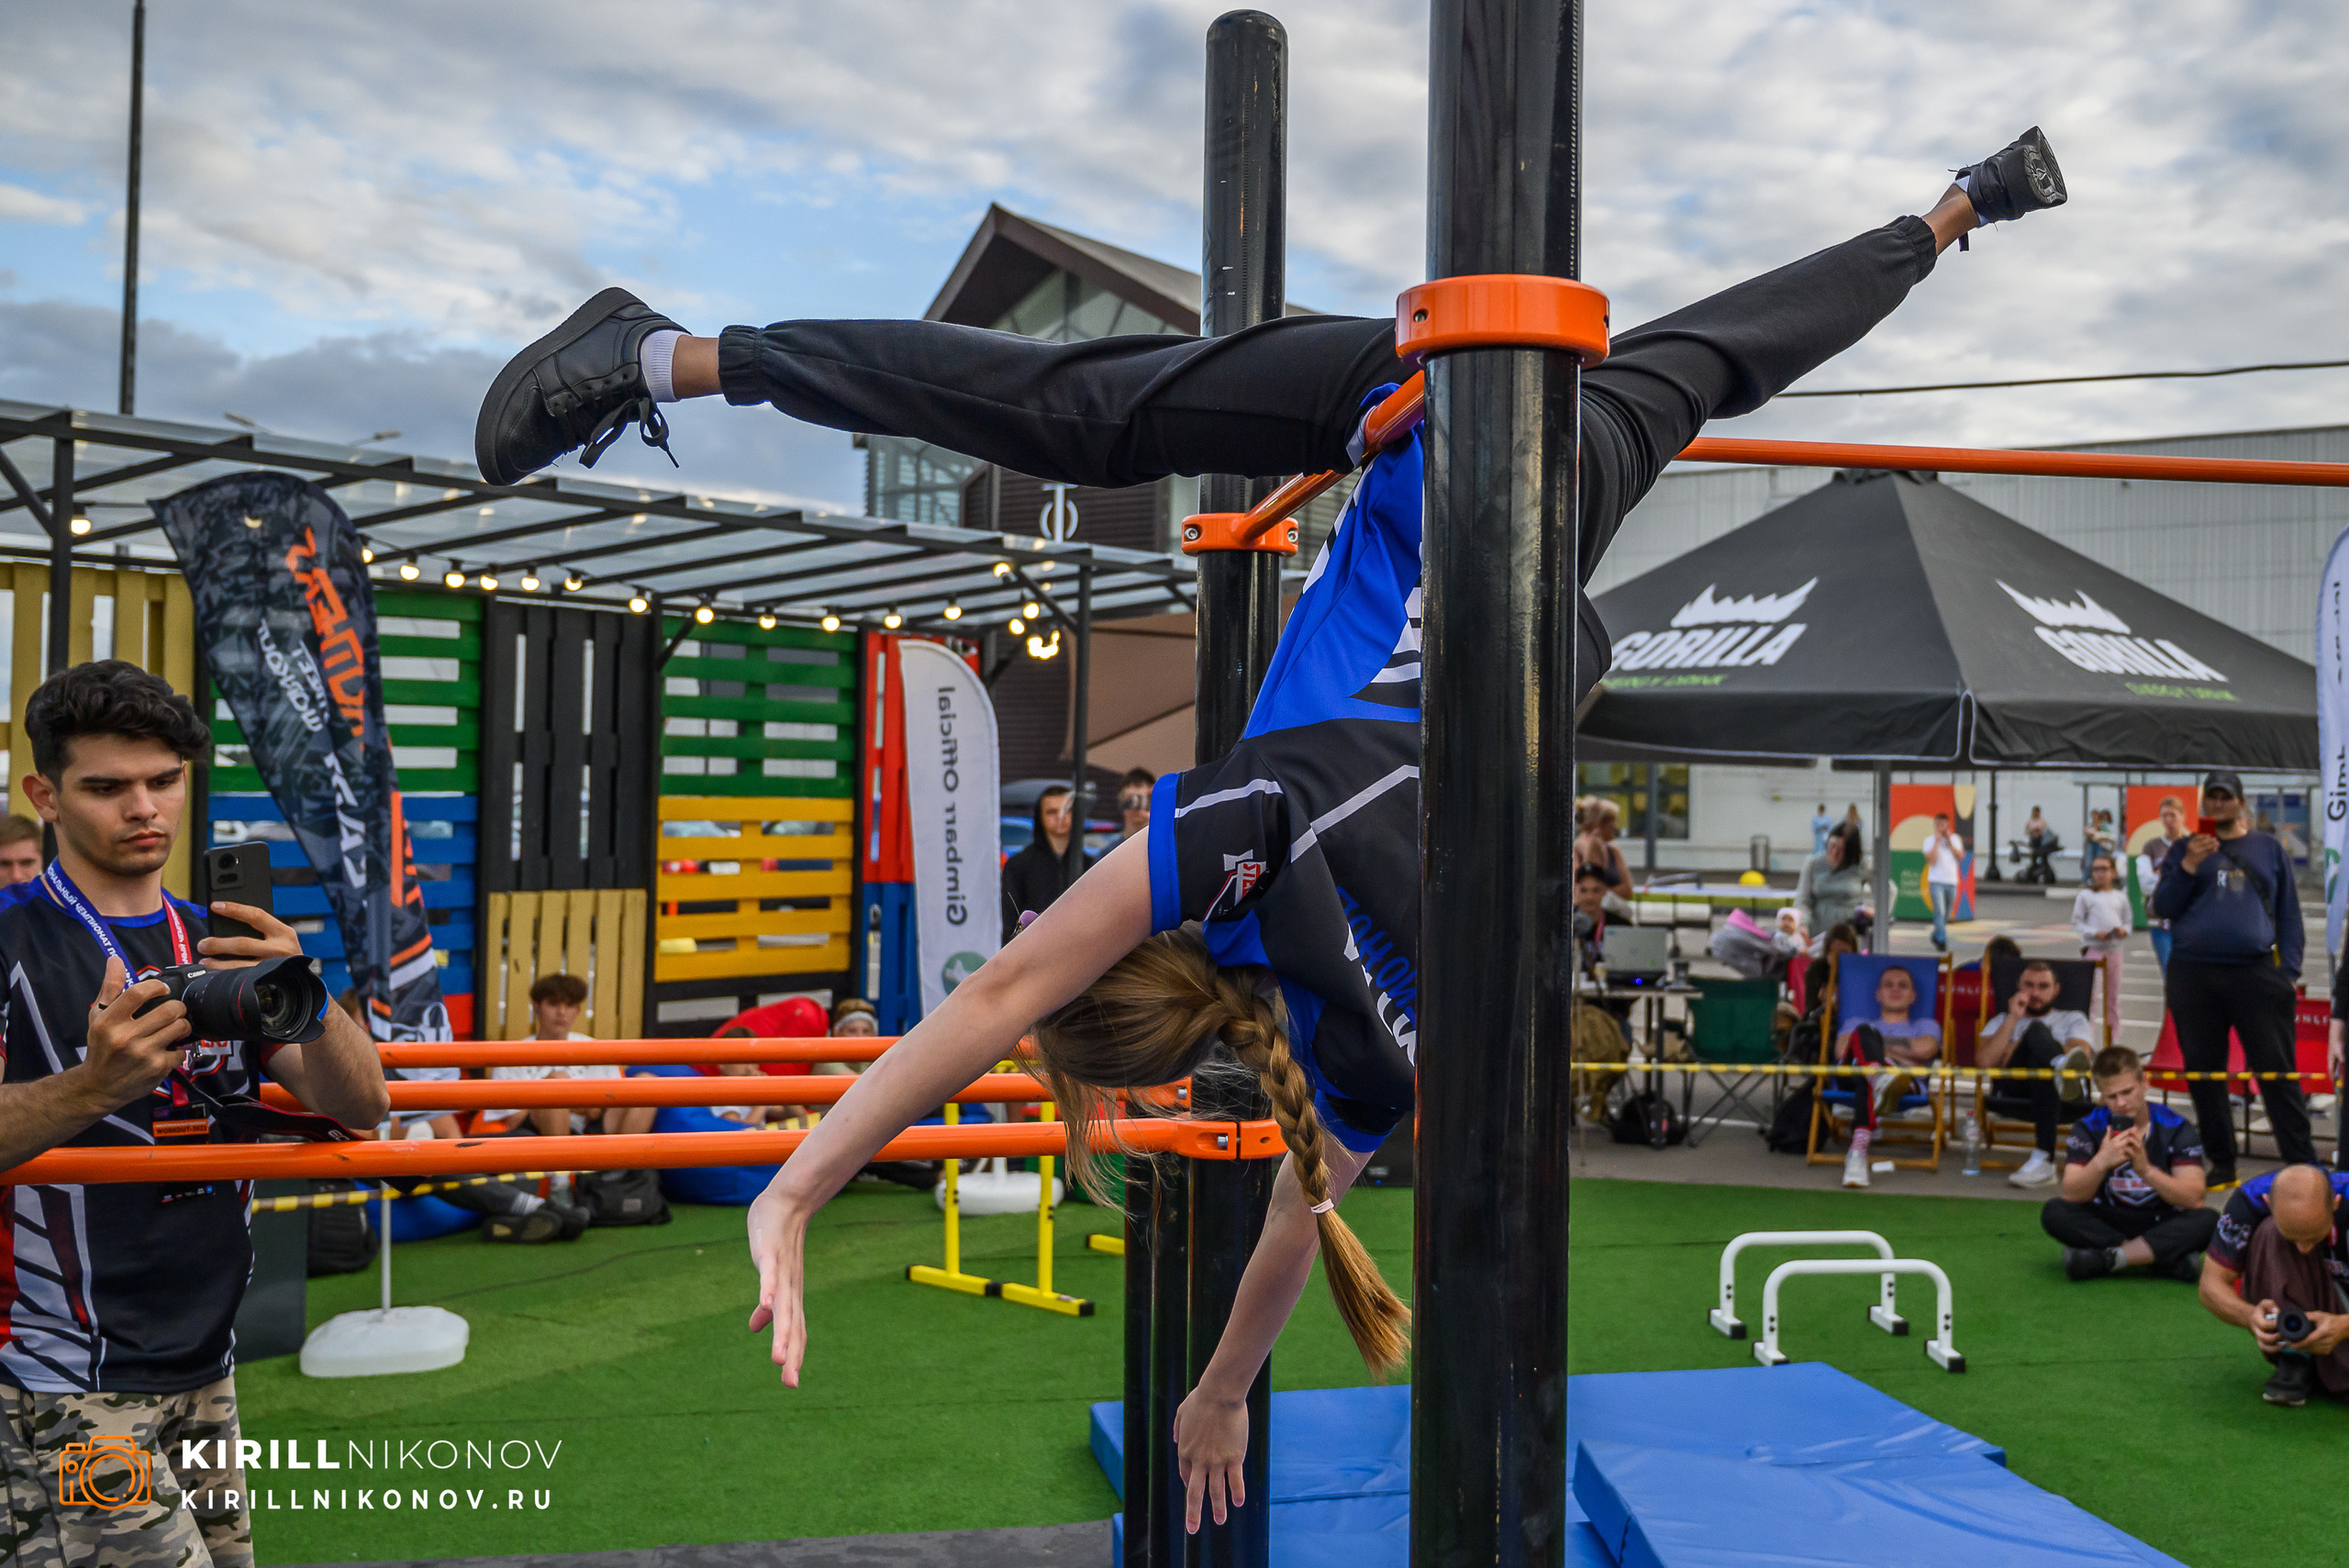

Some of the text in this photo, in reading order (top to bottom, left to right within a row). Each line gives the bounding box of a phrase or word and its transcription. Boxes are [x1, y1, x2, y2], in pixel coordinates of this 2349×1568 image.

[1611, 623, 1808, 671] GORILLA
[2033, 626, 2230, 683] GORILLA
[75, 902, 112, 947] ЧЕМПИОНАТ
[187, 970, 206, 979] Canon
